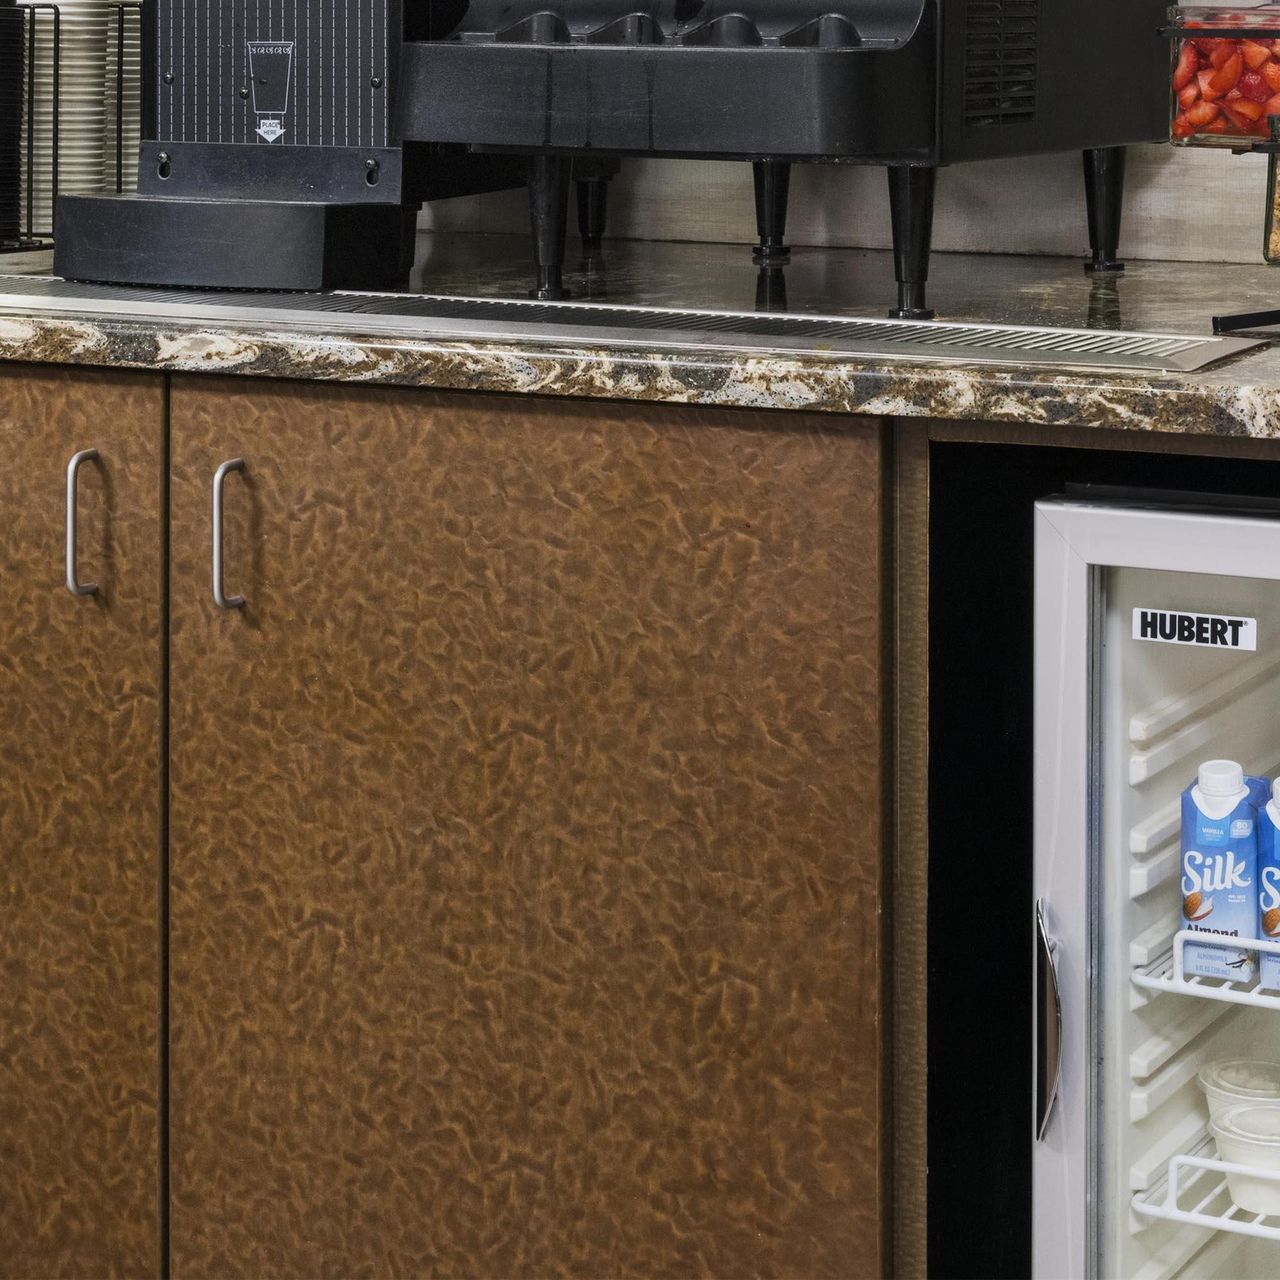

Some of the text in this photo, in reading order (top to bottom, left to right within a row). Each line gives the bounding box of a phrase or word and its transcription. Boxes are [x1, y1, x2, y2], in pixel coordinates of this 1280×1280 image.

[1140, 610, 1245, 647] HUBERT
[1201, 827, 1224, 836] VANILLA
[1181, 850, 1252, 895] Silk
